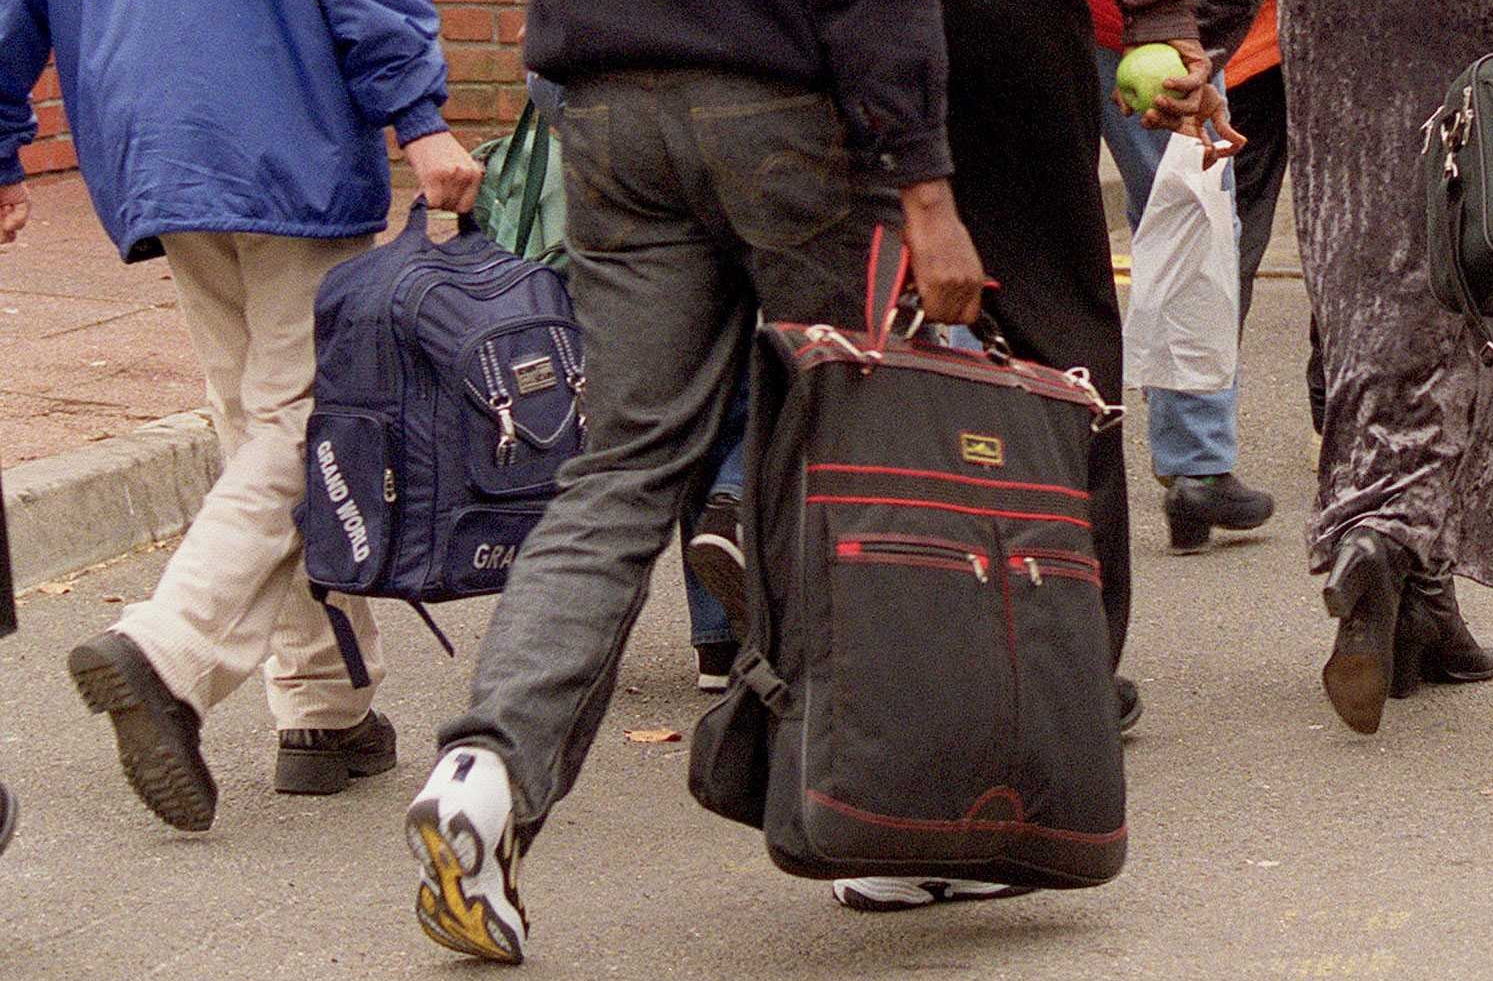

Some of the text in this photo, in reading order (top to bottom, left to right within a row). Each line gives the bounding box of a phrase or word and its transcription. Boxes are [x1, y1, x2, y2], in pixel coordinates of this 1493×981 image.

[317, 440, 370, 562] GRAND WORLD
[473, 543, 516, 569] GRA
